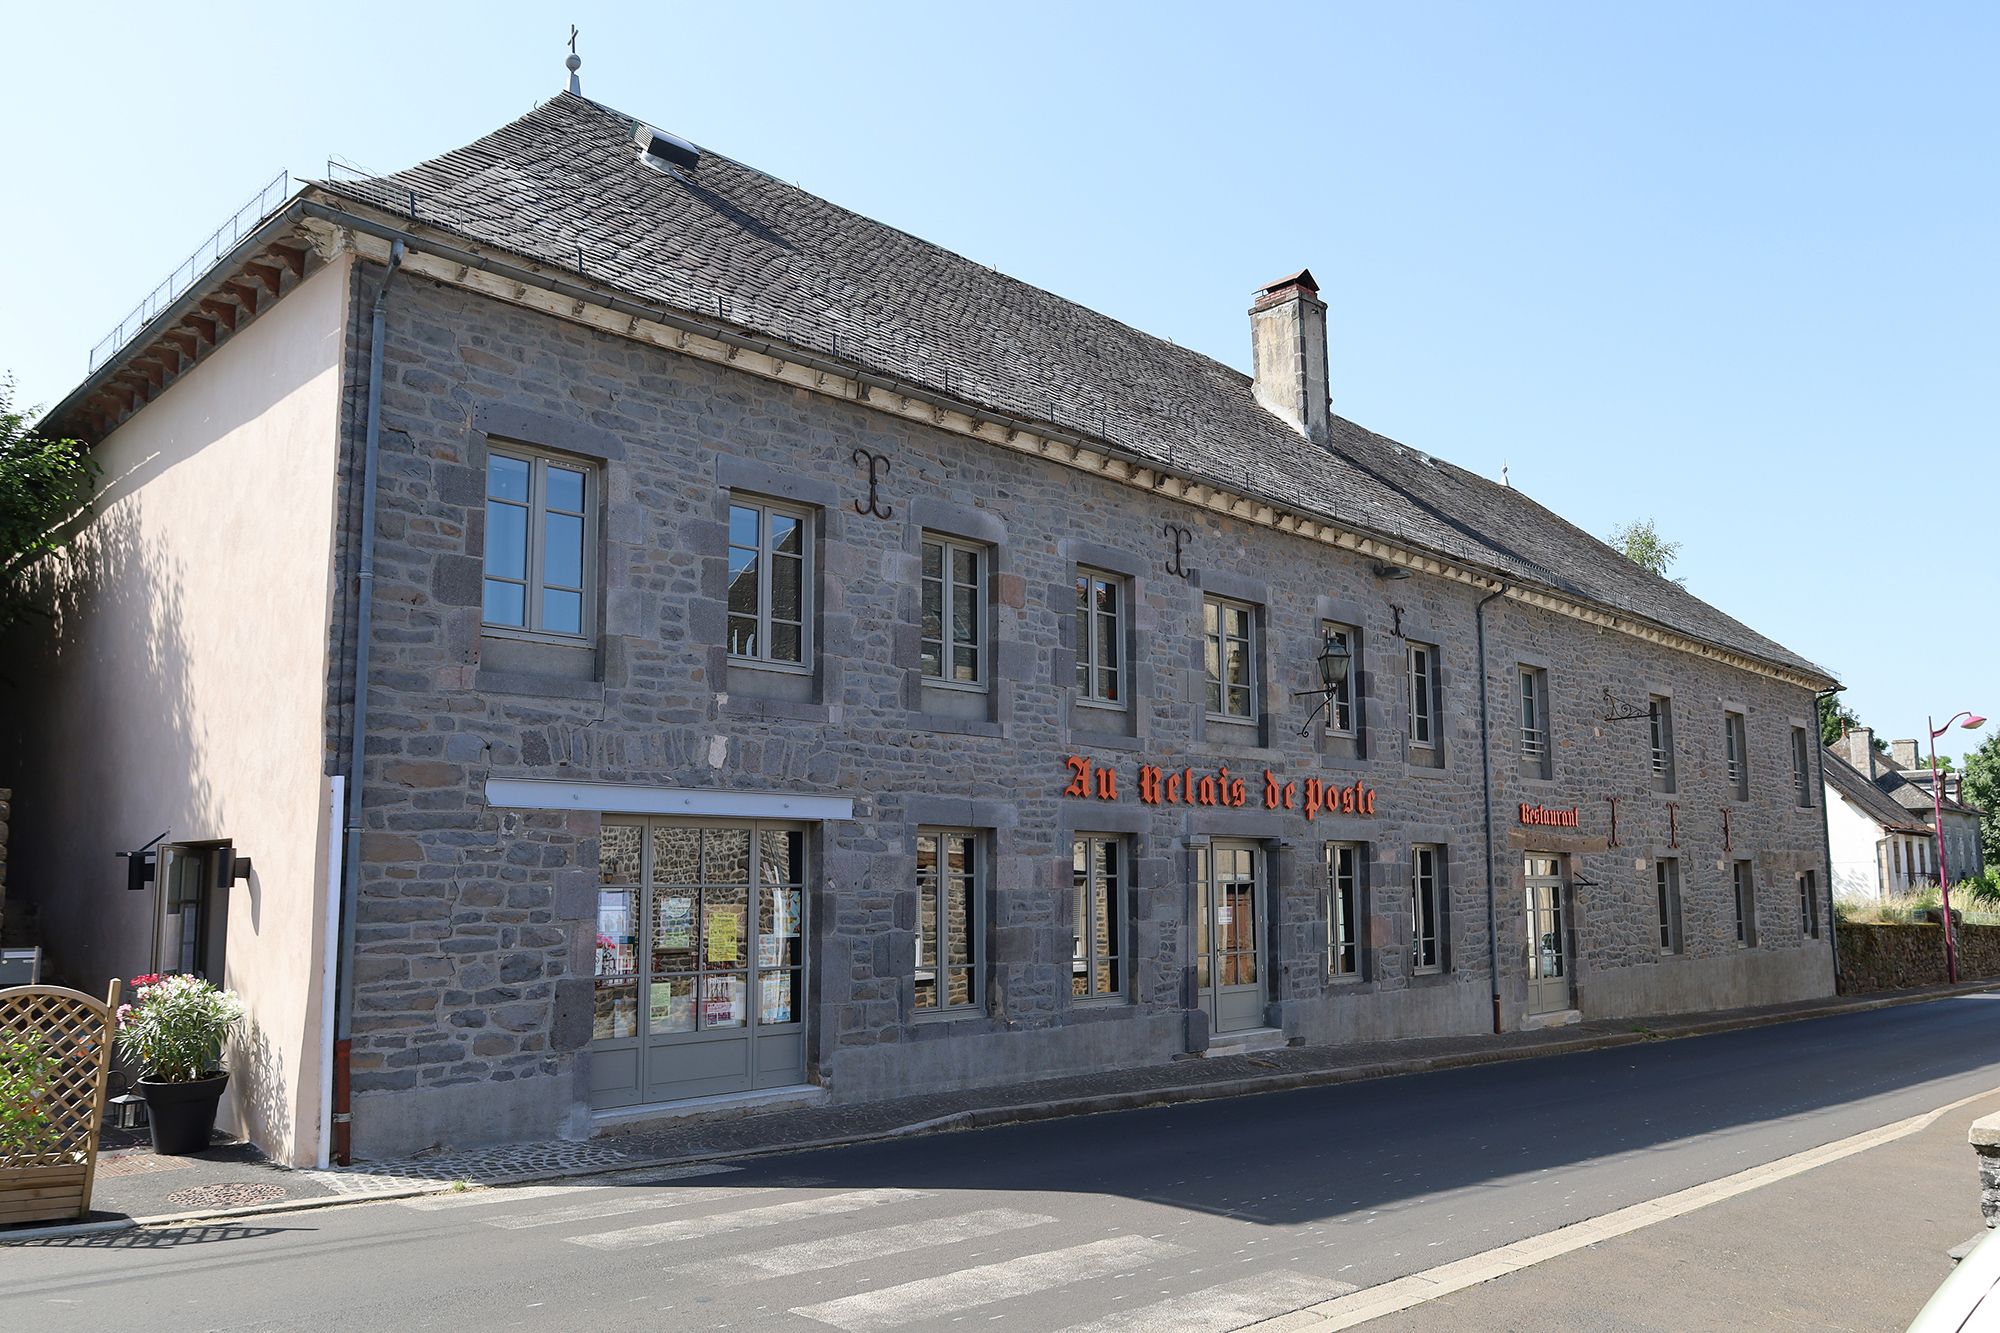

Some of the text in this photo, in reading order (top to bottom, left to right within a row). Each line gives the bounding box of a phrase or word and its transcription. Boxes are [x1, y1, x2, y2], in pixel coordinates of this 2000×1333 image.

[1063, 756, 1118, 800] Au
[1139, 764, 1246, 807] Relais
[1264, 769, 1296, 810] de
[1520, 804, 1579, 828] Restaurant
